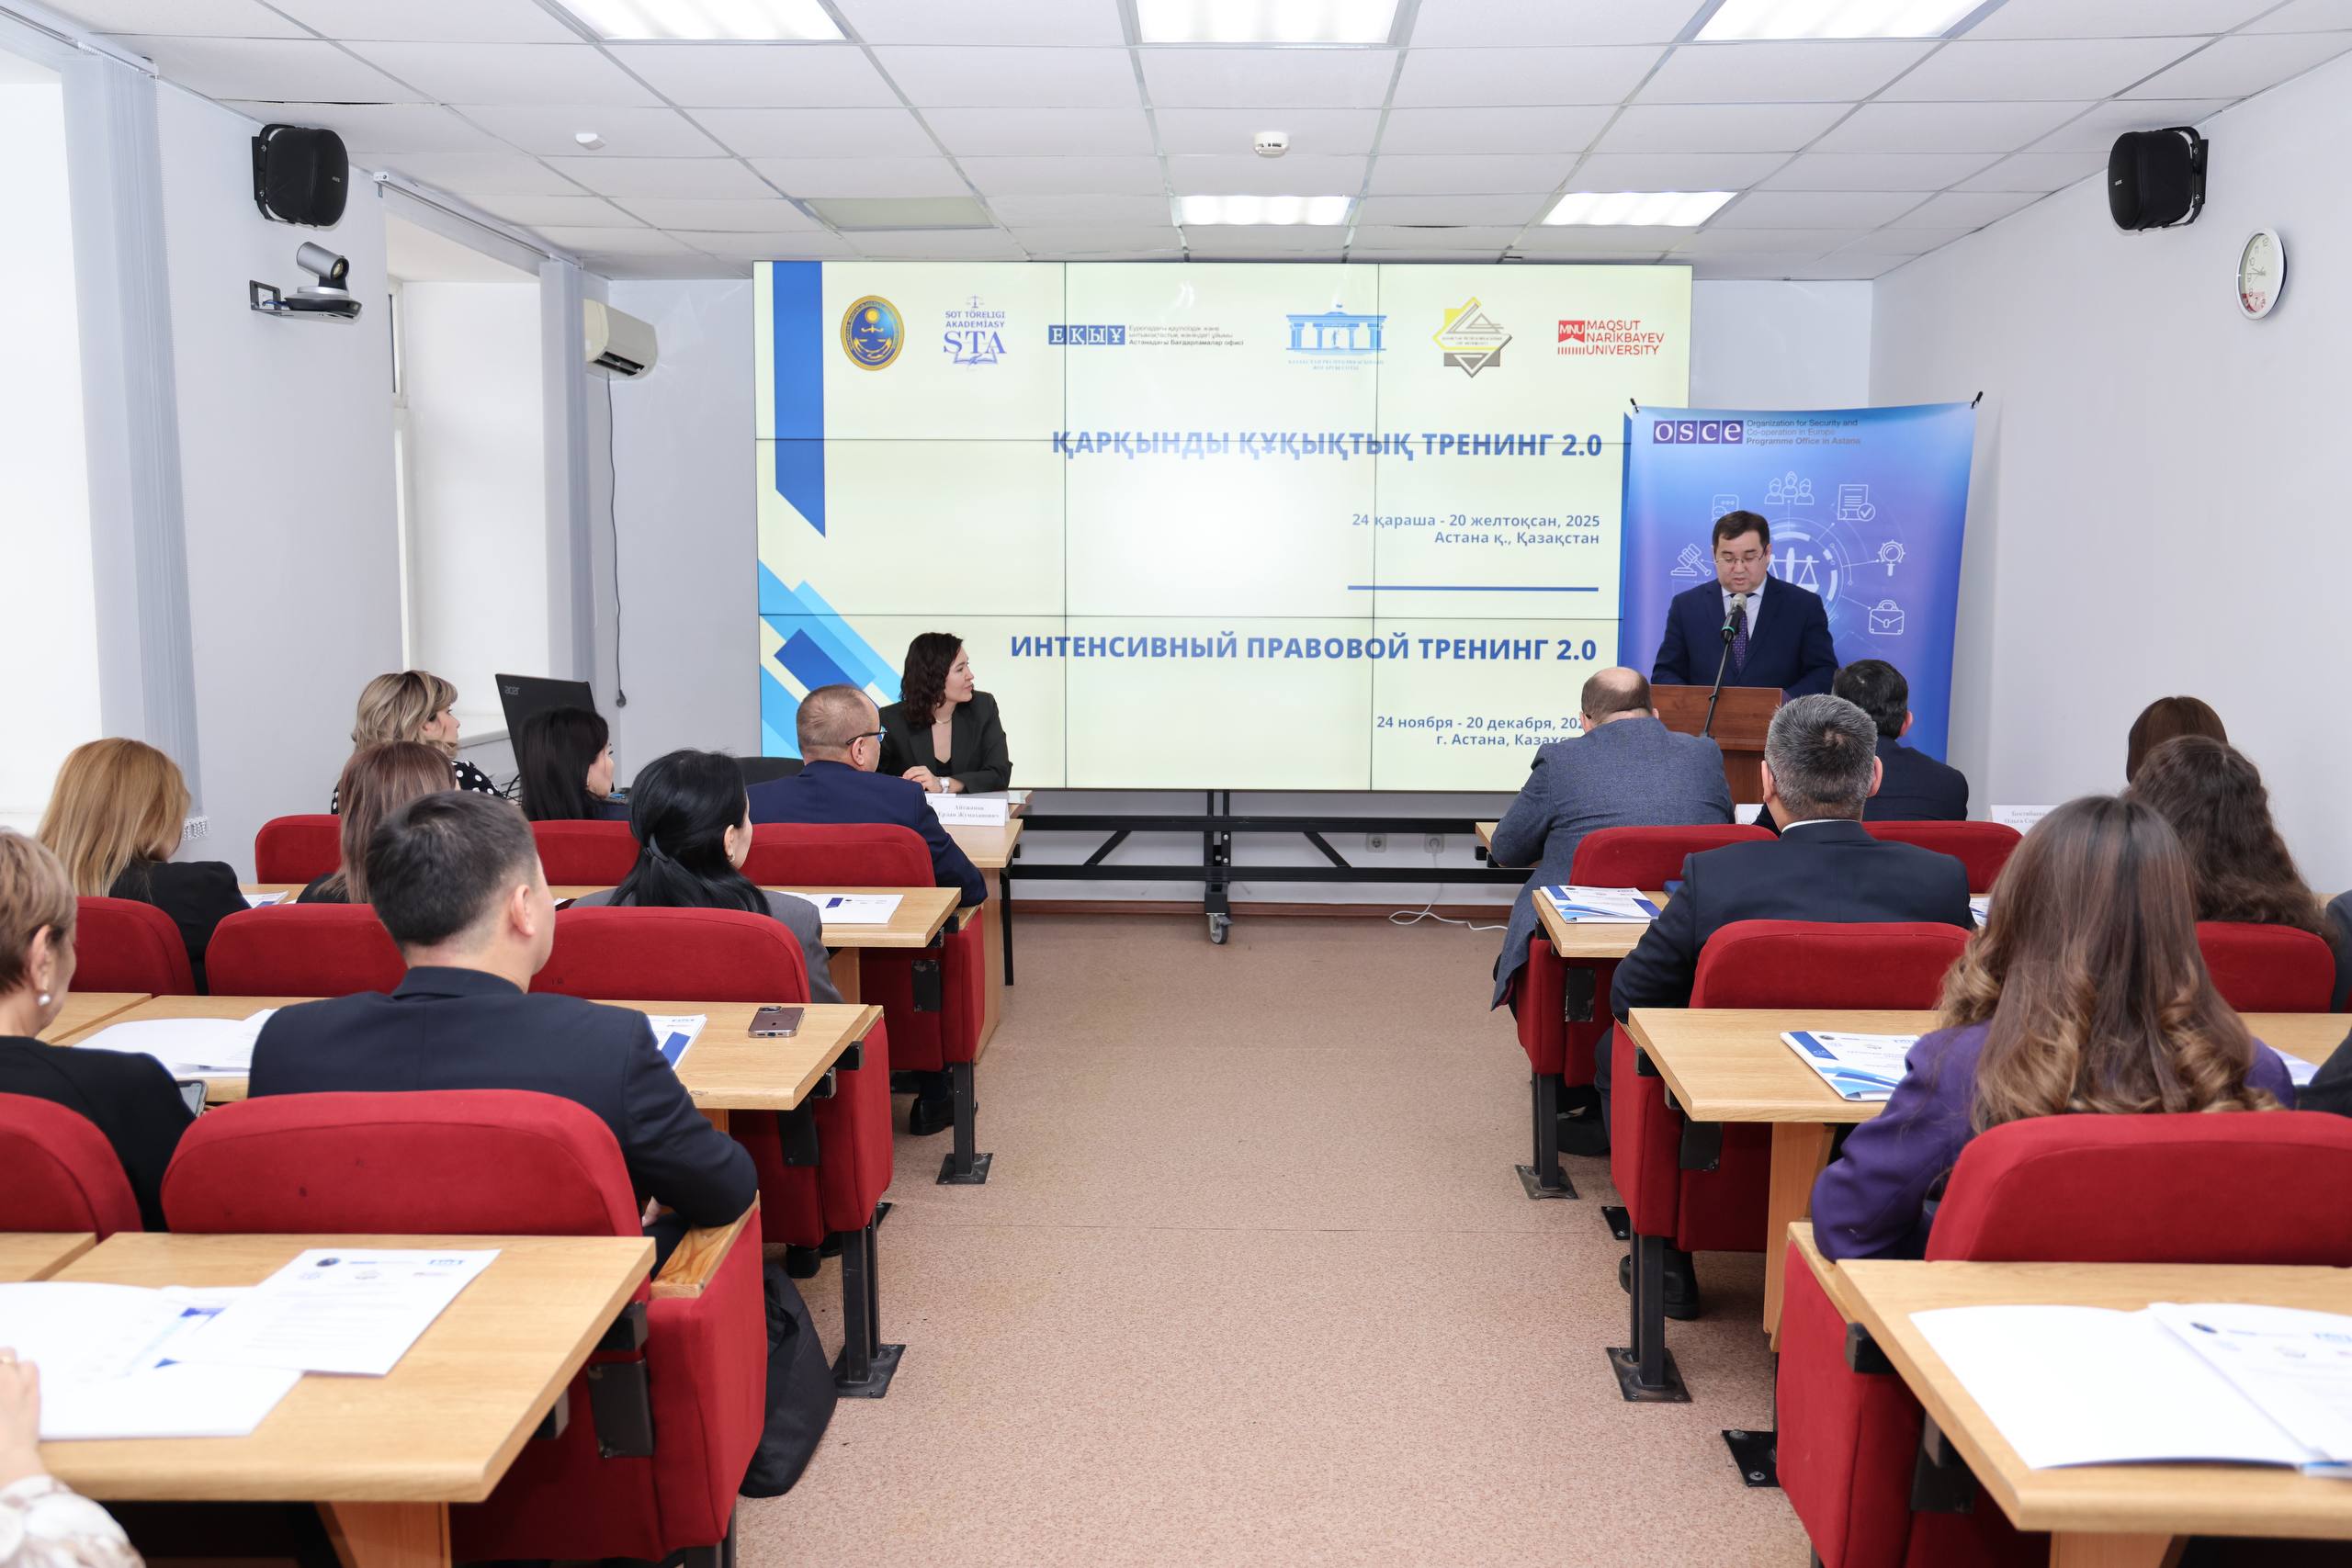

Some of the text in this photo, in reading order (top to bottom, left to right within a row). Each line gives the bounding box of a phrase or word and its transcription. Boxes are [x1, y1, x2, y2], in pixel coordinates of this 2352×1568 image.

[945, 310, 962, 319] SOT
[1559, 324, 1584, 335] MNU
[1587, 320, 1641, 333] MAQSUT
[944, 330, 1007, 354] STA
[1050, 326, 1124, 345] ЕҚЫҰ
[1587, 332, 1665, 344] NARIKBAYEV
[1587, 344, 1659, 355] UNIVERSITY
[1747, 419, 1858, 429] Organization for Security and
[1747, 428, 1797, 437] Co-operation
[1808, 428, 1837, 437] Europe
[1053, 431, 1602, 461] ҚАРҚЫНДЫ ҚҰҚЫҚТЫҚ ТРЕНИНГ 2.0
[1747, 437, 1794, 446] Programme
[1795, 437, 1820, 446] Office
[1833, 437, 1860, 446] Astana
[1352, 513, 1369, 525] 24
[1374, 516, 1436, 529] қараша
[1449, 514, 1466, 526] 20
[1470, 515, 1561, 529] желтоқсан,
[1566, 514, 1600, 527] 2025
[1434, 531, 1489, 544] Астана
[1517, 532, 1600, 547] Қазақстан
[1011, 630, 1597, 660] ИНТЕНСИВНЫЙ ПРАВОВОЙ ТРЕНИНГ 2.0
[1377, 716, 1394, 728] 24
[1398, 716, 1453, 731] ноября
[1466, 716, 1484, 728] 20
[1487, 716, 1555, 732] декабря,
[1437, 736, 1447, 746] г.
[1452, 734, 1510, 748] Астана,
